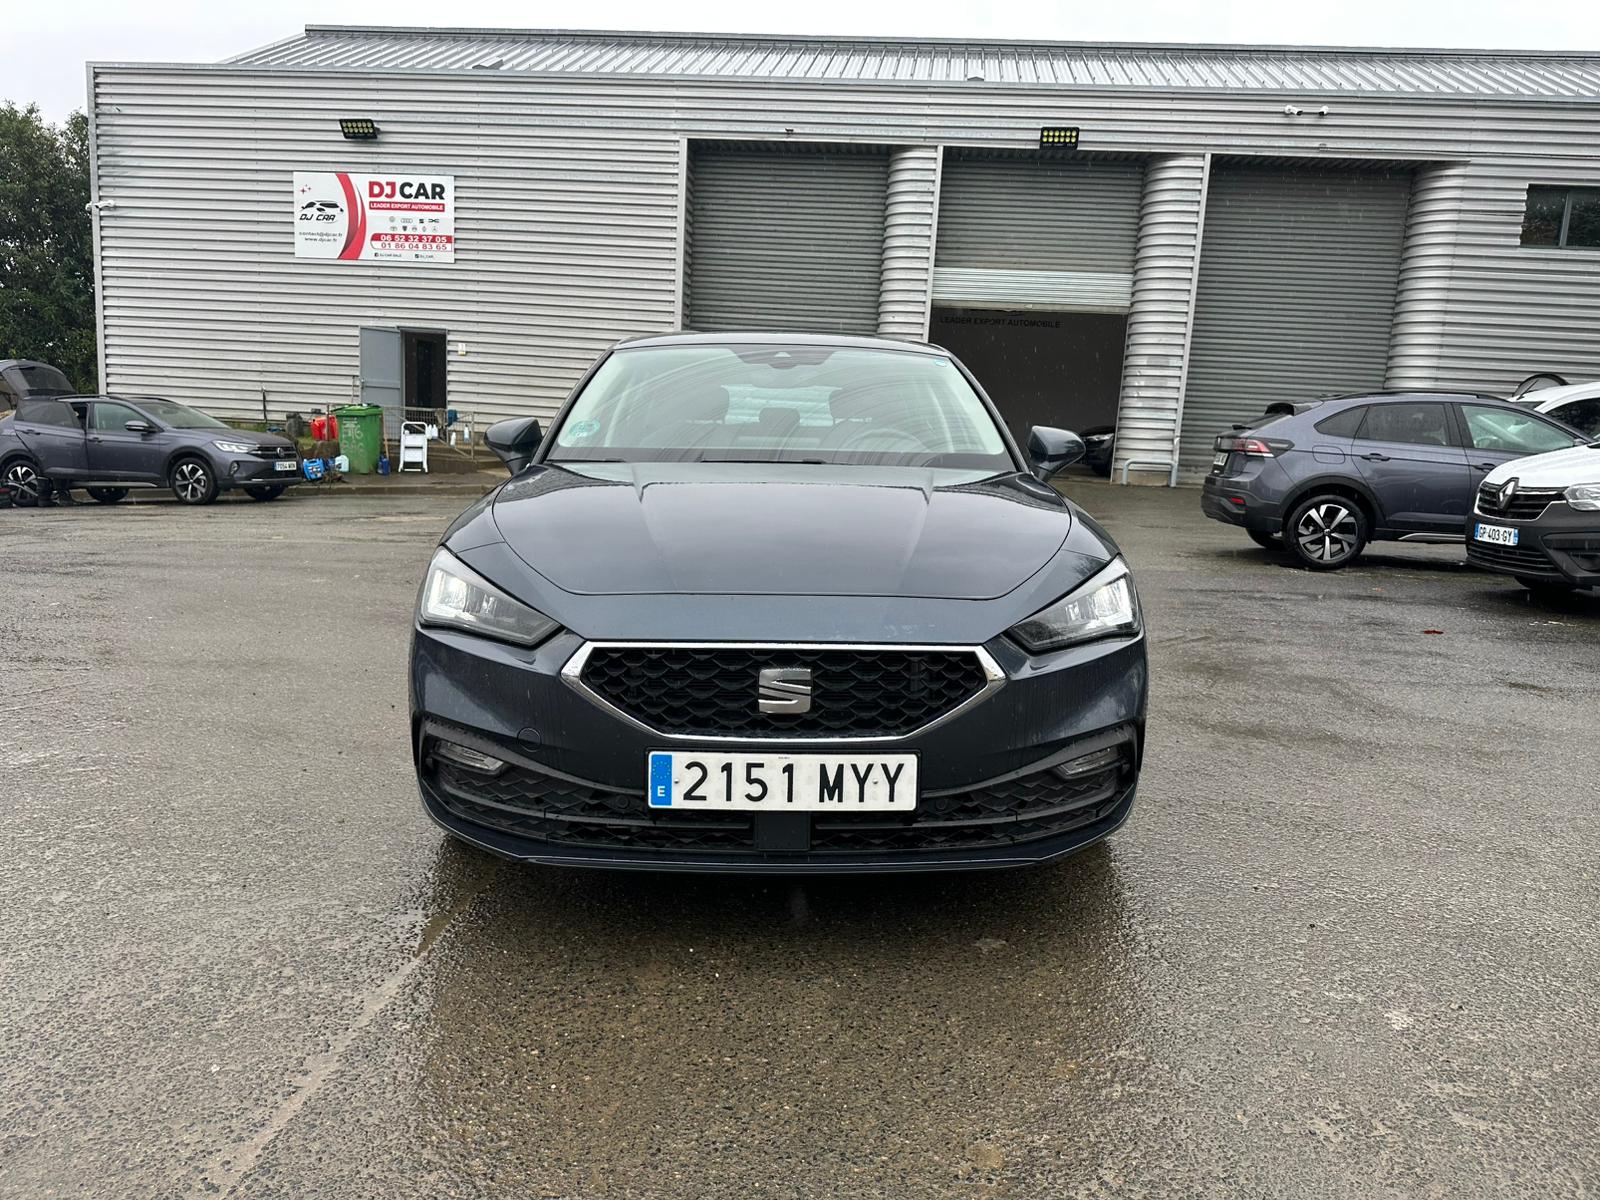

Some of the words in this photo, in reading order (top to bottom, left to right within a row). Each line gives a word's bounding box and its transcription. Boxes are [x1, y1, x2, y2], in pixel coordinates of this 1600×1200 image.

[368, 181, 396, 198] DJ
[400, 182, 445, 200] CAR
[1007, 320, 1061, 328] AUTOMOBILE
[657, 786, 665, 797] E
[683, 761, 794, 803] 2151
[818, 763, 905, 803] MYY
